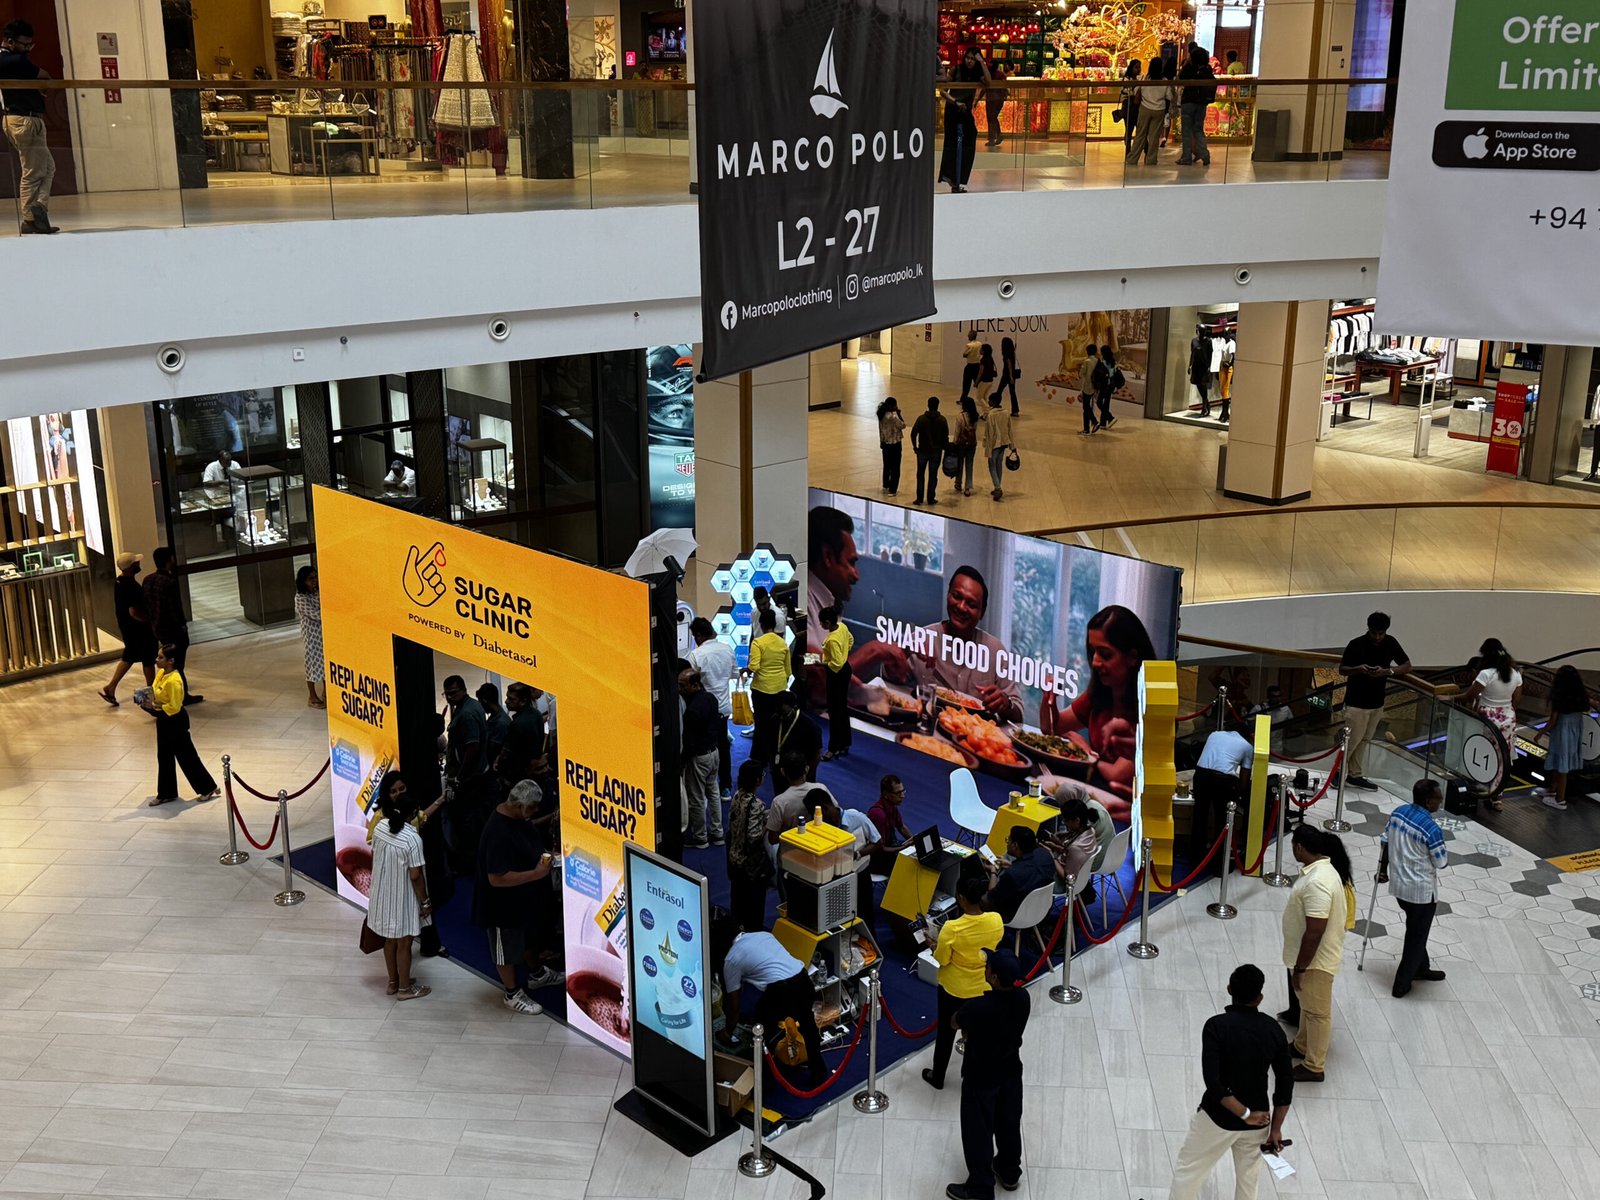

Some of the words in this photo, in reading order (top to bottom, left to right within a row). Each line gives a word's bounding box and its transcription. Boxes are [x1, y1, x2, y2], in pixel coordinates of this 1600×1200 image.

[1502, 15, 1599, 44] Offer
[1498, 58, 1600, 90] Limit
[1493, 143, 1529, 161] App
[1531, 143, 1577, 160] Store
[1495, 130, 1540, 140] Download
[1541, 132, 1553, 140] on
[1554, 131, 1570, 140] the
[717, 135, 834, 180] MARCO
[851, 127, 924, 165] POLO
[1529, 206, 1587, 230] +94
[777, 216, 815, 271] L2
[844, 206, 880, 258] 27
[741, 287, 833, 318] Marcopoloclothing
[862, 264, 923, 292] @marcopolo_lk
[1493, 418, 1522, 439] 30
[670, 489, 685, 497] TO
[454, 575, 533, 619] SUGAR
[408, 612, 452, 636] POWERED
[453, 628, 466, 641] BY
[455, 599, 530, 640] CLINIC
[472, 633, 538, 669] Diabetasol
[876, 615, 938, 657] SMART
[942, 633, 990, 674] FOOD
[996, 648, 1079, 700] CHOICES
[329, 661, 391, 707] REPLACING
[341, 690, 385, 730] SUGAR?
[1472, 747, 1490, 771] L1
[361, 751, 391, 804] Diabetasol
[565, 758, 647, 816] REPLACING
[579, 795, 637, 841] SUGAR?
[646, 881, 684, 909] Entrasol
[683, 977, 695, 990] 22
